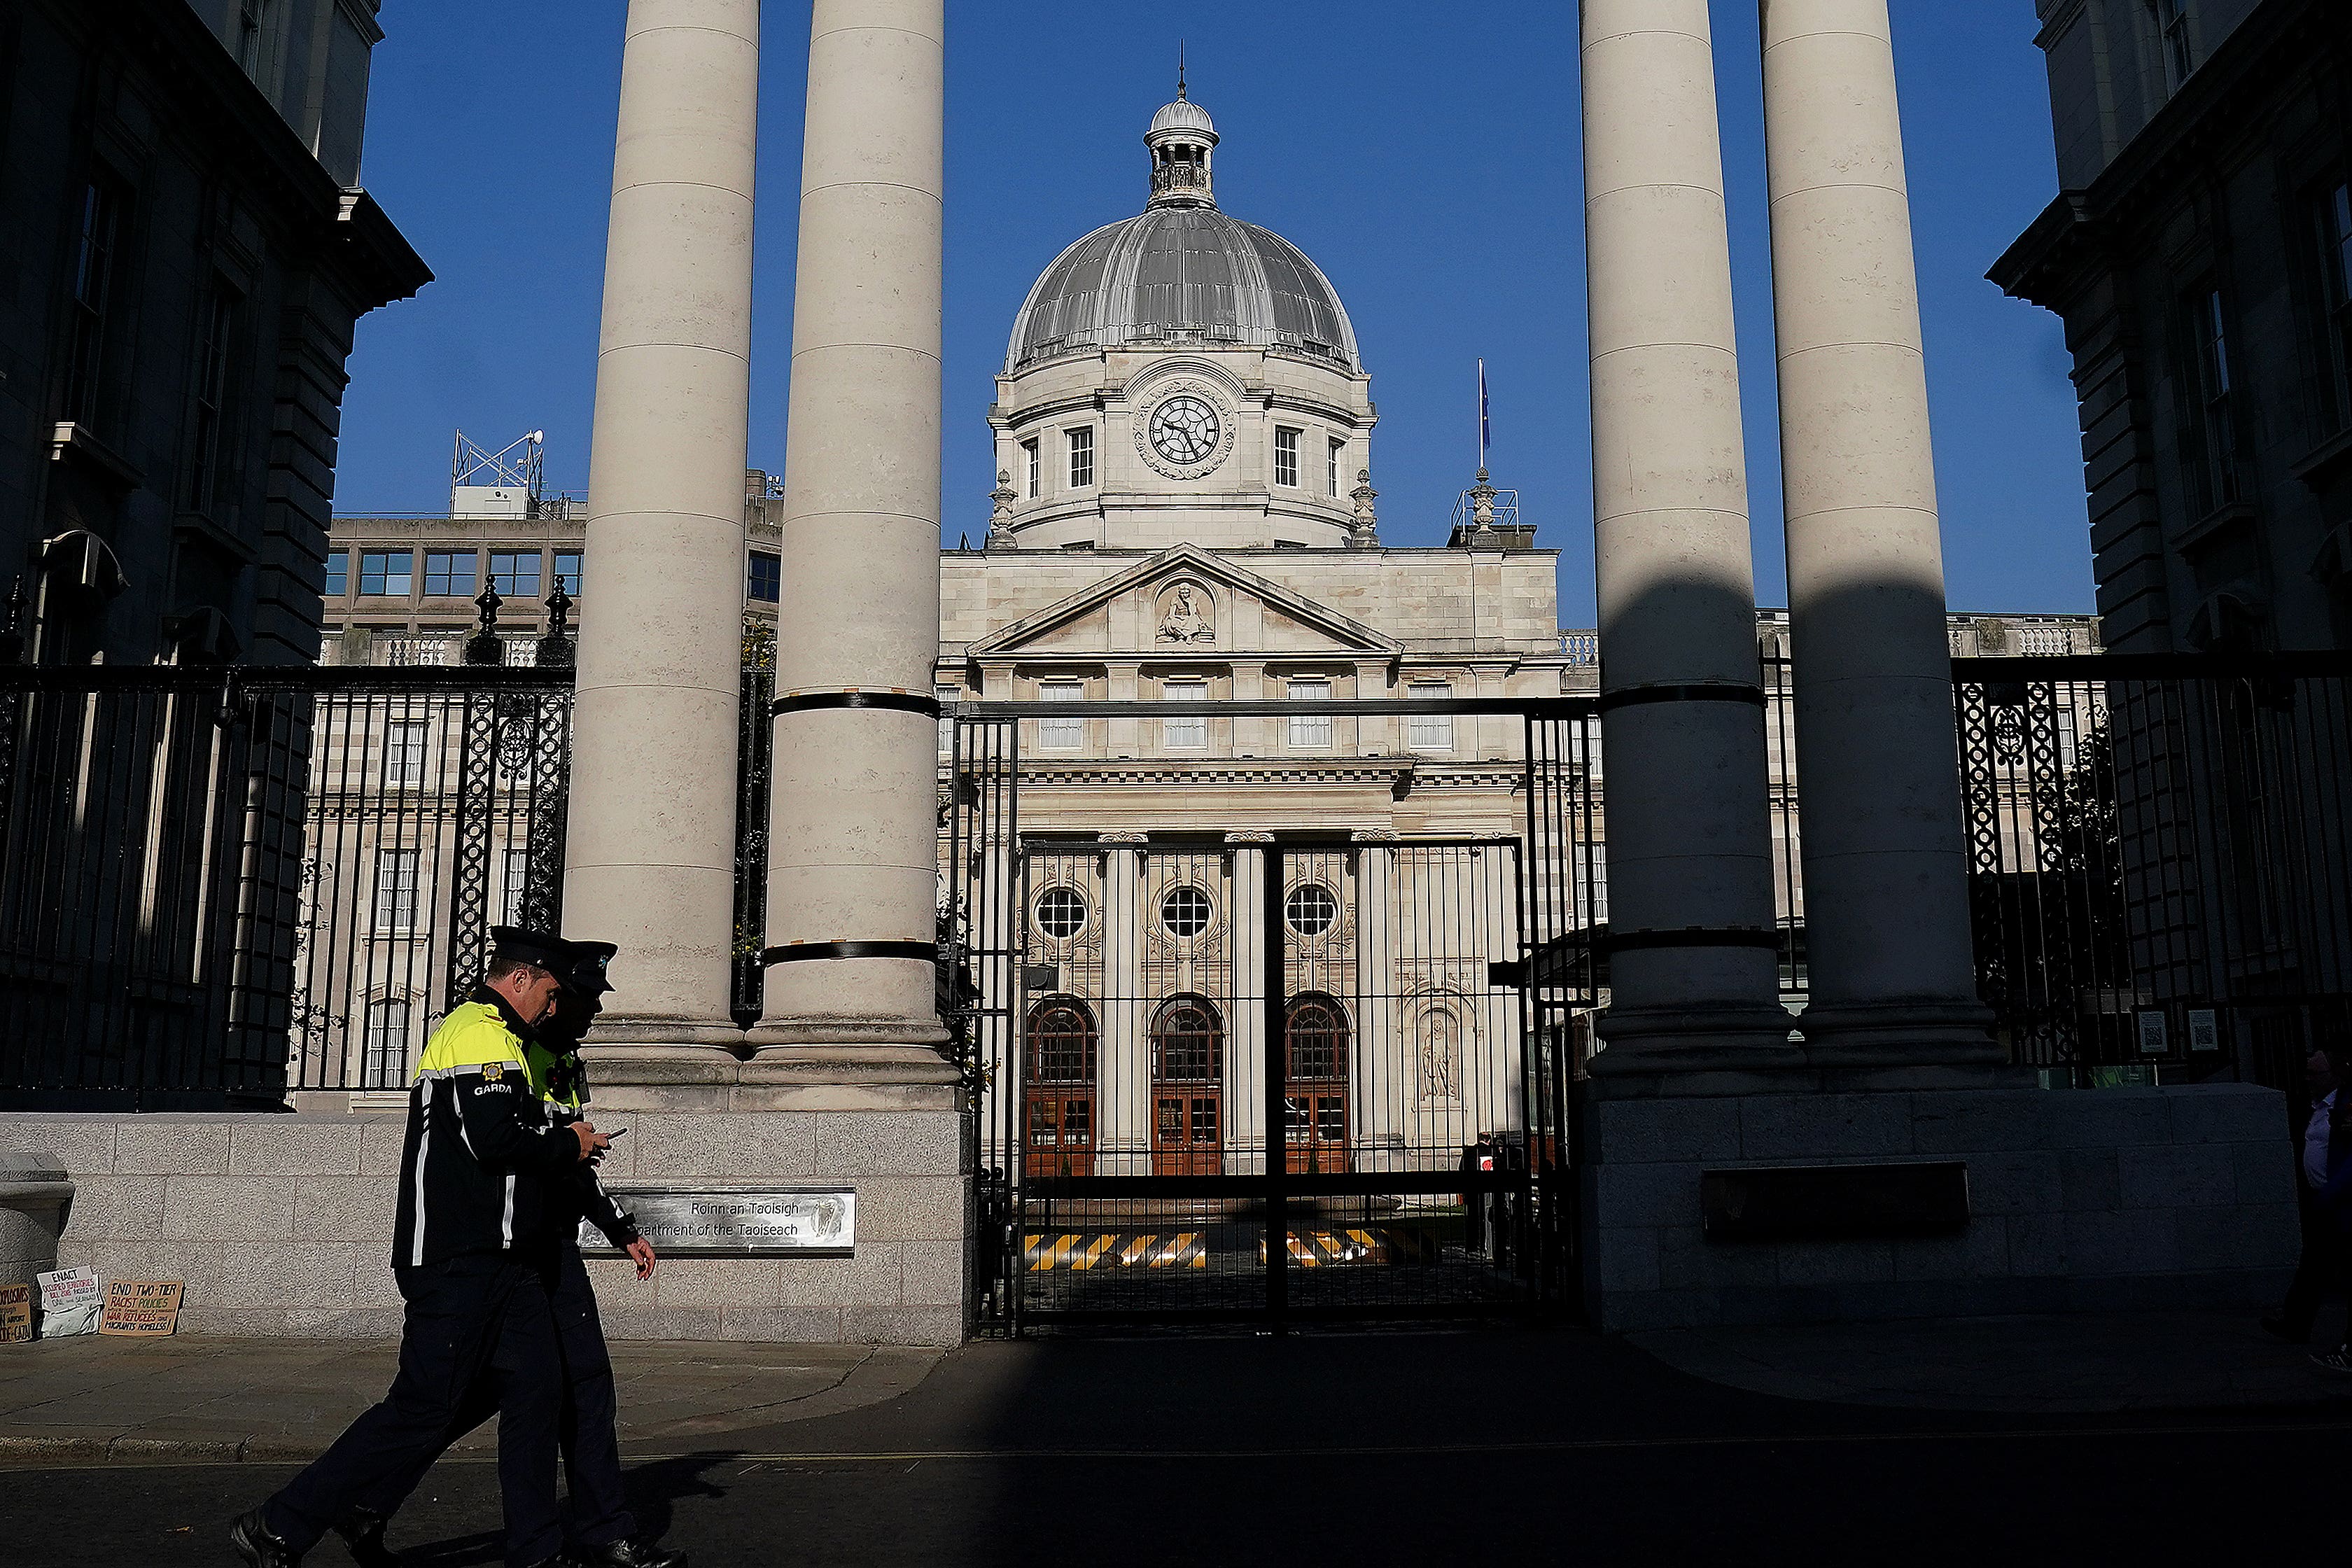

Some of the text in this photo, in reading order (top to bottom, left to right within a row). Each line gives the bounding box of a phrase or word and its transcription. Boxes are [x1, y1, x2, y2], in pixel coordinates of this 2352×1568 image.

[474, 1084, 512, 1096] GARDA
[691, 1202, 799, 1217] Roinn an Taoisigh
[637, 1224, 798, 1237] partment of the Taoiseach
[52, 1268, 78, 1283] ENACT
[111, 1282, 177, 1296] END TWO-TIER
[111, 1296, 169, 1309] RACIST POLICIES
[106, 1311, 122, 1321] WAR
[122, 1311, 156, 1322] REFUGEES
[104, 1321, 136, 1331] MIGRANTS
